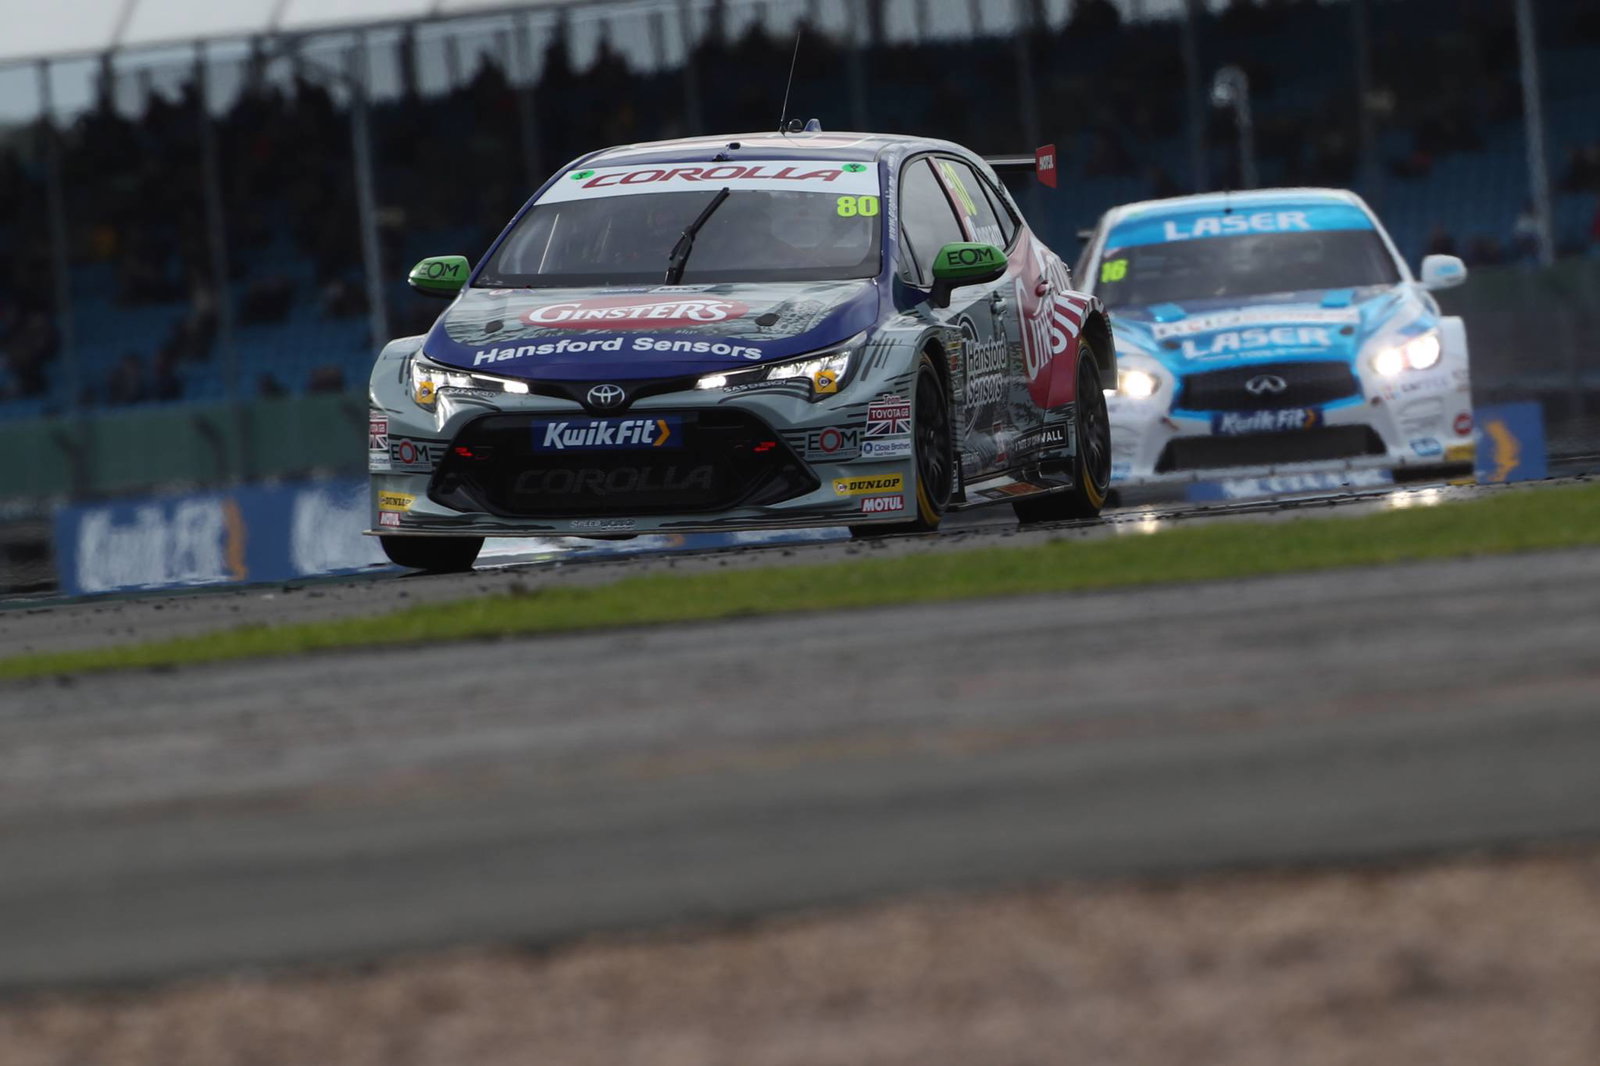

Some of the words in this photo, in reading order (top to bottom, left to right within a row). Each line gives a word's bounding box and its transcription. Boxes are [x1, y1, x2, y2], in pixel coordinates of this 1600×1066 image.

[581, 166, 844, 189] COROLLA
[837, 196, 879, 217] 80
[1164, 211, 1311, 241] LASER
[947, 248, 994, 265] EOM
[419, 261, 460, 279] EOM
[1102, 259, 1128, 283] 16
[473, 337, 624, 366] Hansford
[632, 337, 762, 360] Sensors
[966, 331, 1007, 374] Hansford
[1182, 327, 1331, 359] LASER
[965, 373, 1003, 407] Sensors
[871, 409, 901, 419] TOYOTA
[391, 440, 429, 464] EOM
[808, 429, 858, 453] EOM
[514, 465, 713, 496] COROLLA
[850, 478, 900, 490] DUNLOP
[862, 497, 903, 512] MOTUL
